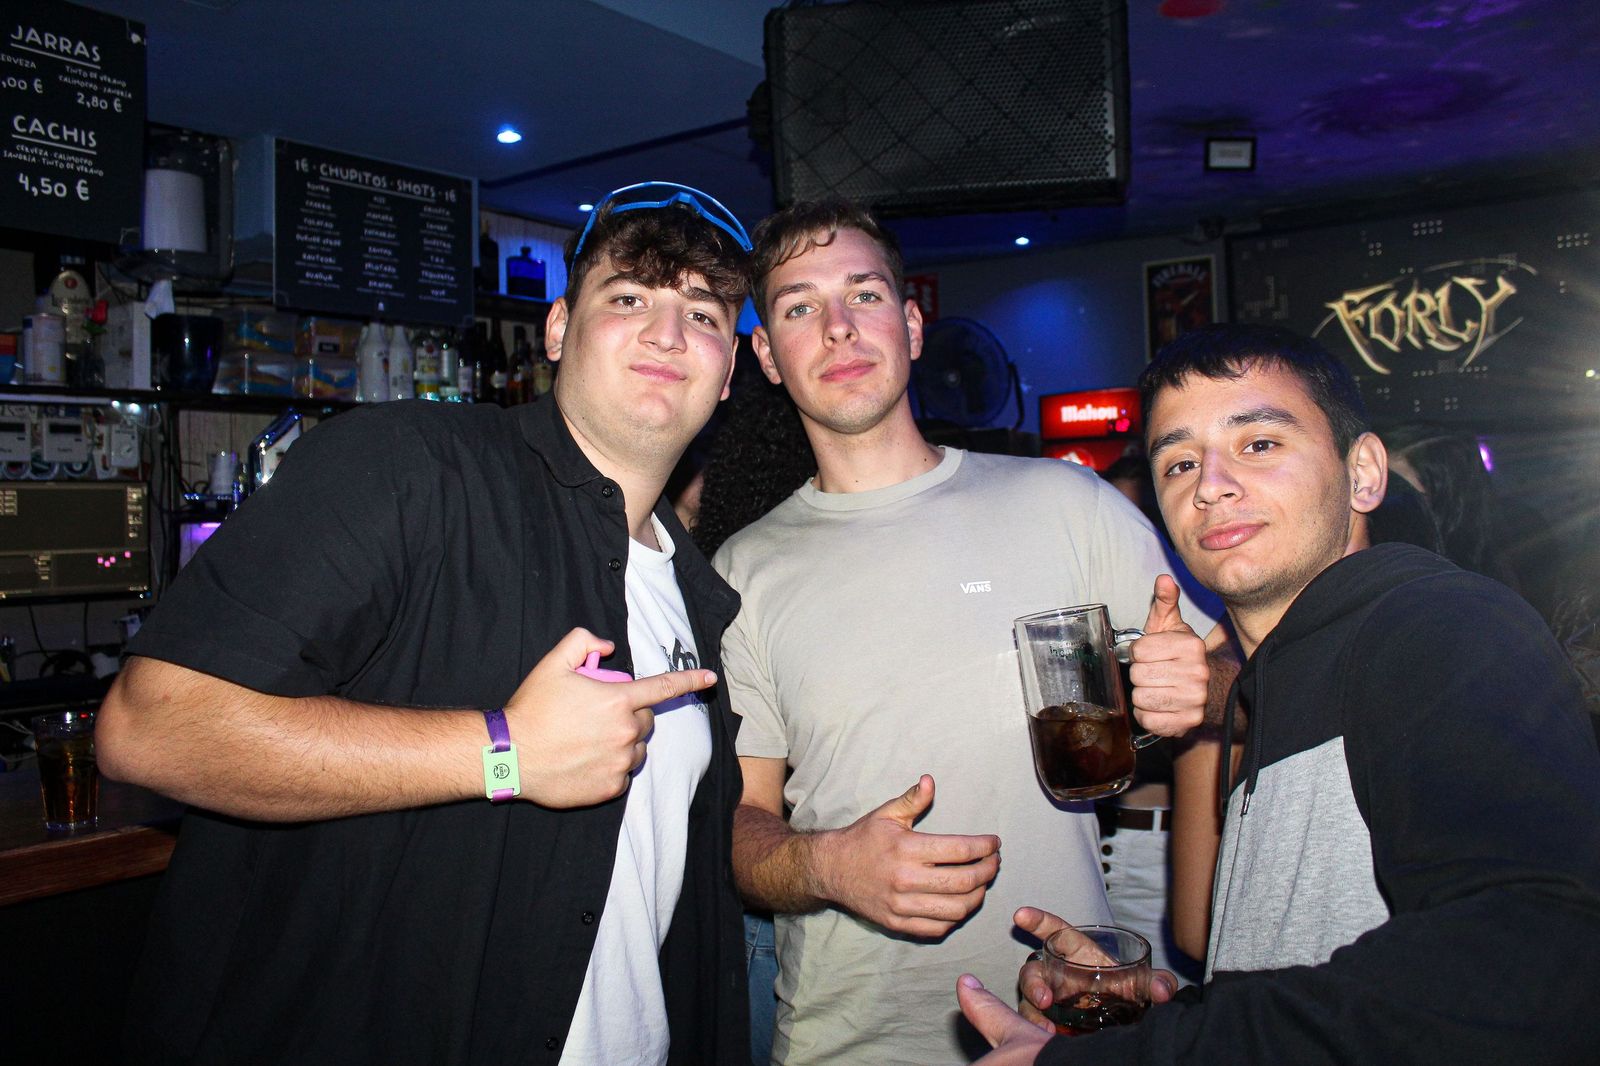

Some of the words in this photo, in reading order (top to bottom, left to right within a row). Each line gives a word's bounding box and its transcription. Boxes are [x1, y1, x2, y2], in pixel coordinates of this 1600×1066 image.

[10, 25, 101, 62] JARRAS
[0, 53, 37, 69] ERVEZA
[1, 77, 28, 91] ,00
[76, 92, 108, 110] 2,80
[113, 97, 122, 113] €
[13, 115, 98, 148] CACHIS
[18, 172, 67, 198] 4,50
[75, 179, 91, 201] €
[320, 163, 387, 188] CHUPITOS
[397, 178, 436, 199] SHOTS
[960, 580, 992, 594] VANS
